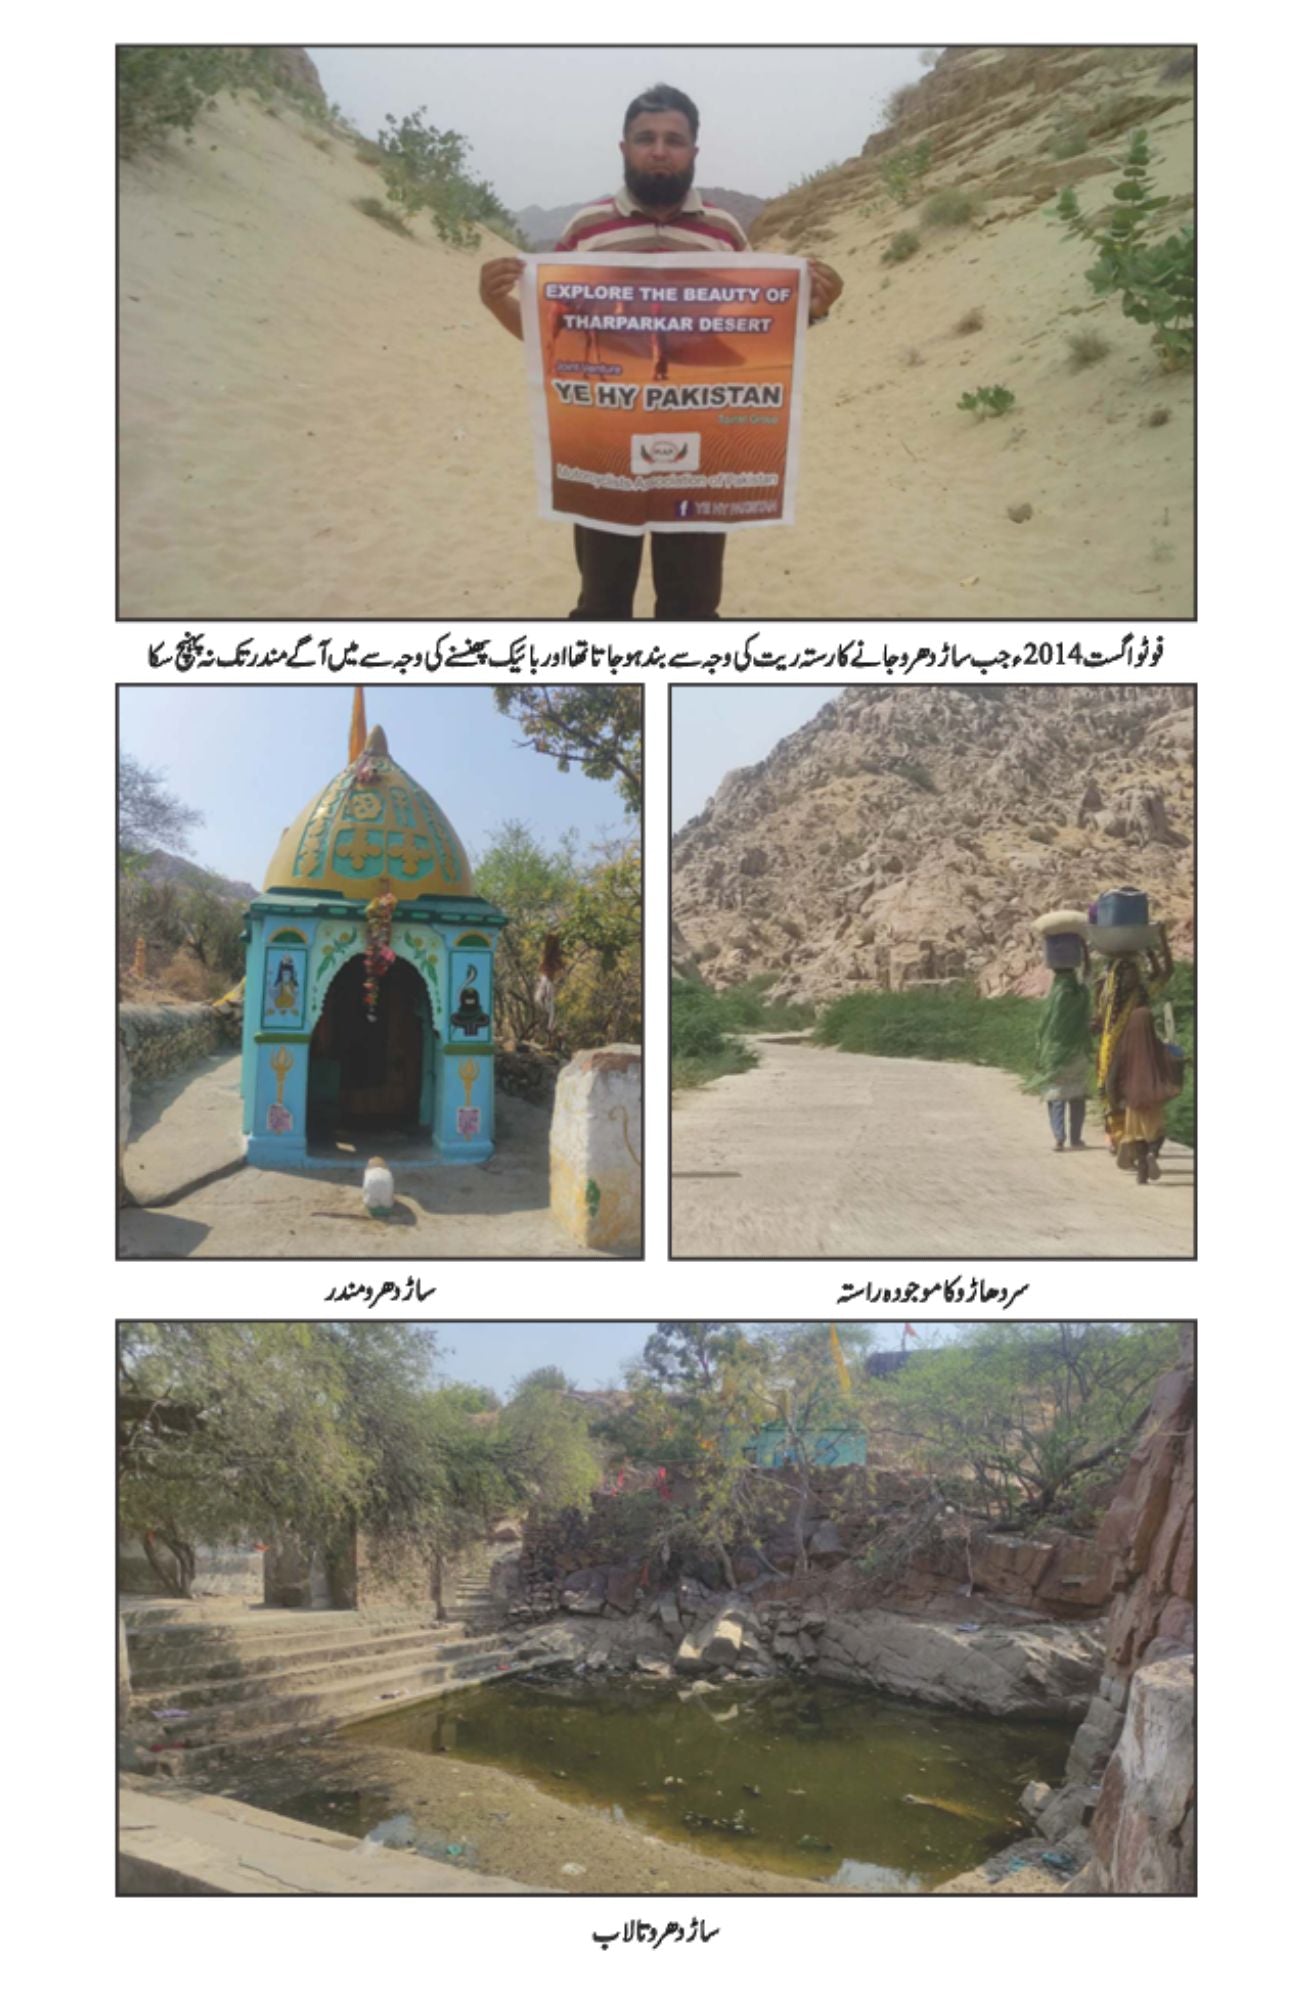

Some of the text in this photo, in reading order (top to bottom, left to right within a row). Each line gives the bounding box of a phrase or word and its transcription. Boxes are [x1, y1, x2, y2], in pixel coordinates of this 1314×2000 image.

[546, 284, 791, 303] EXPLORE THE BEAUTY OF
[563, 314, 772, 333] THARPARKAR DESERT
[554, 380, 783, 410] YE HY PAKISTAN
